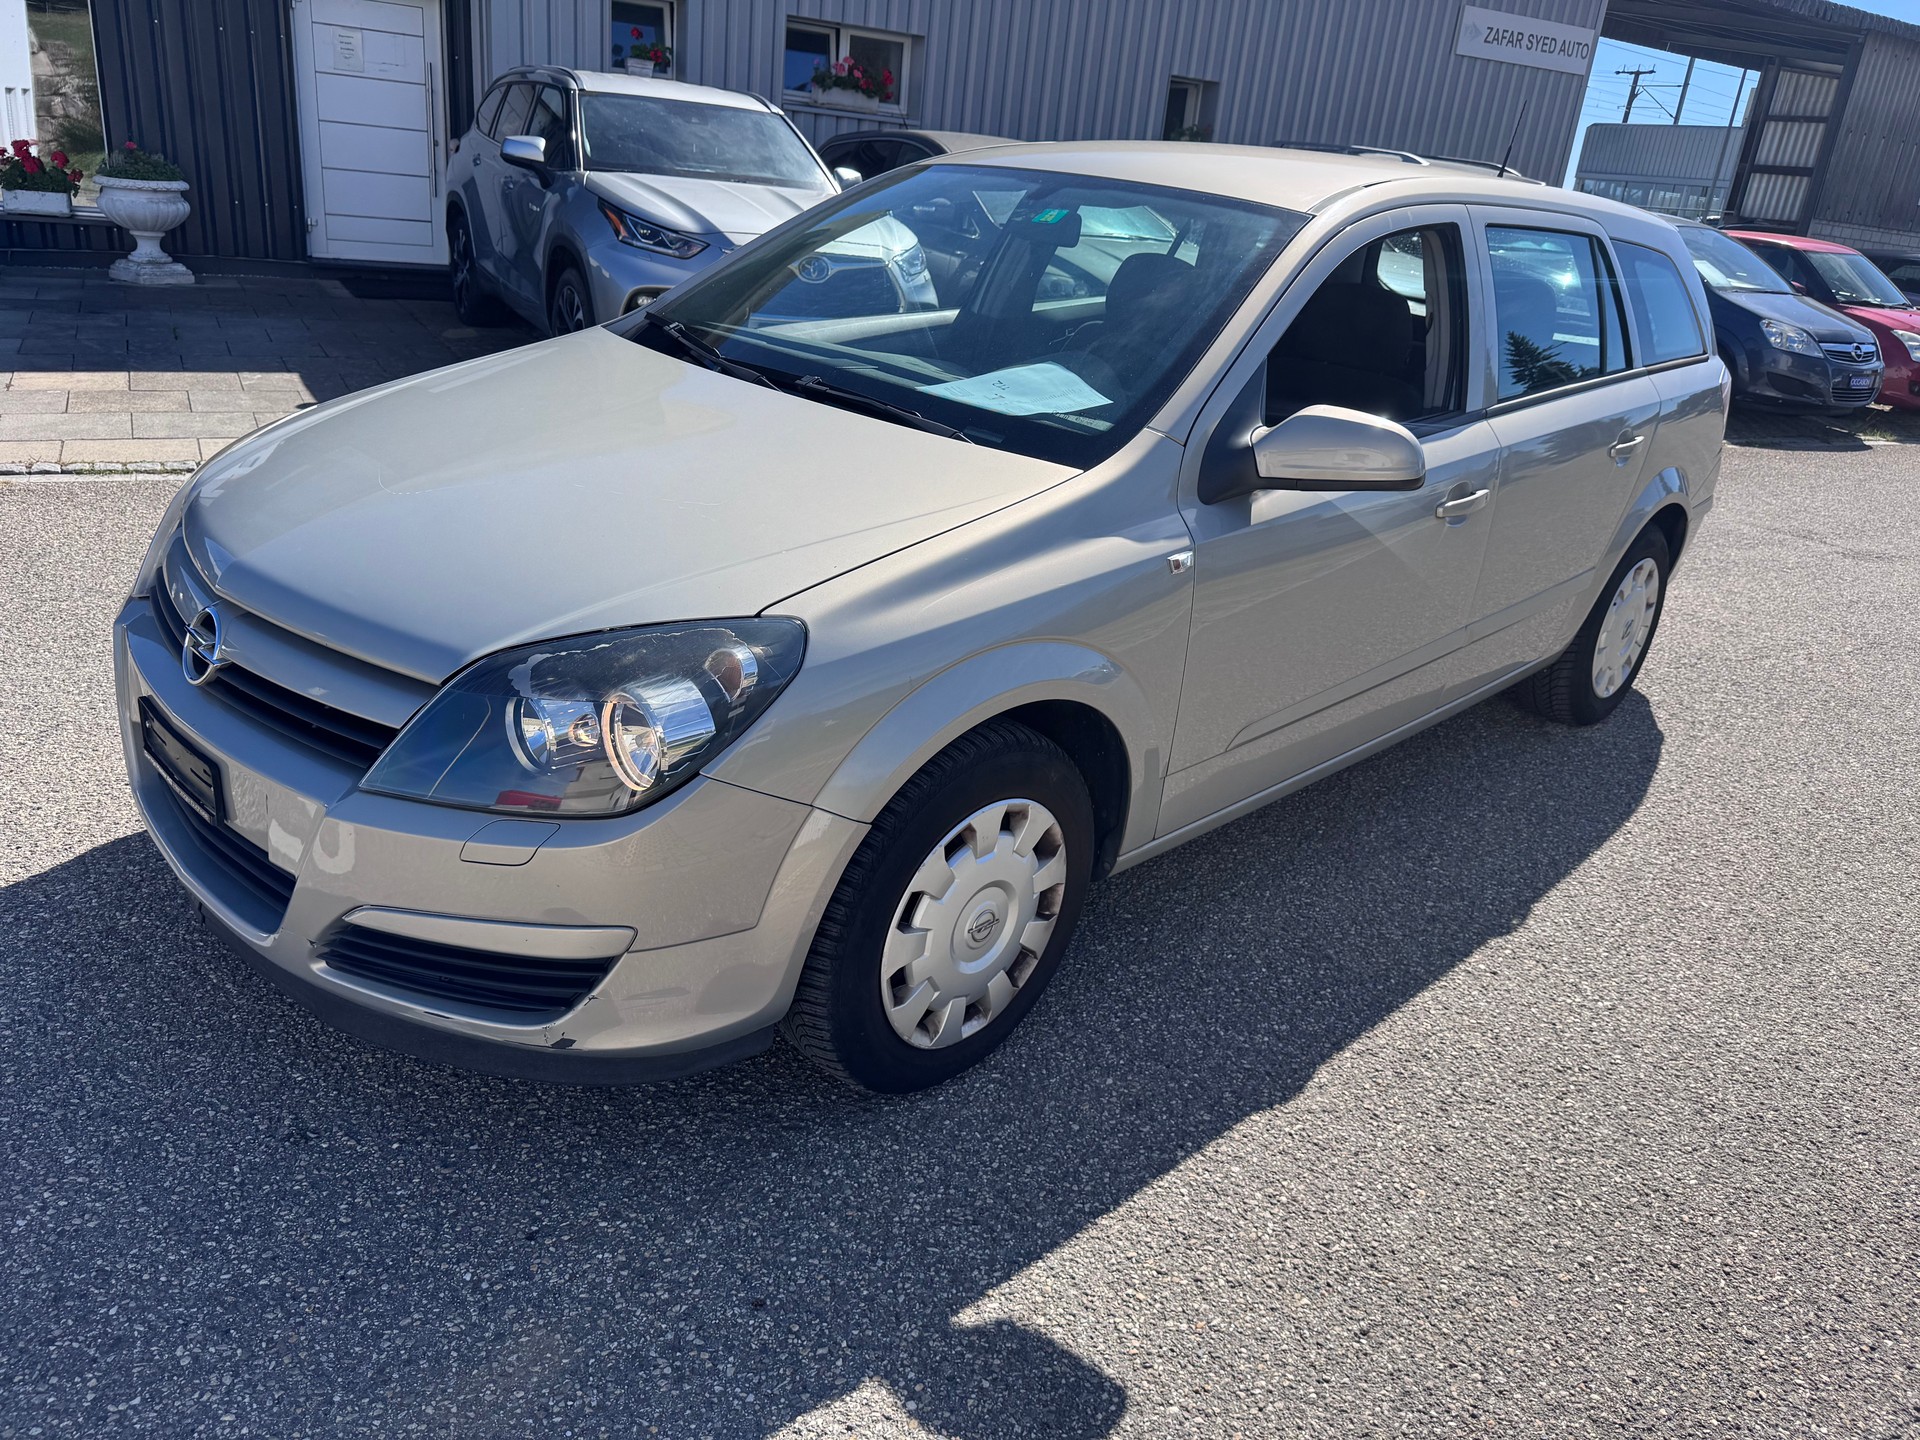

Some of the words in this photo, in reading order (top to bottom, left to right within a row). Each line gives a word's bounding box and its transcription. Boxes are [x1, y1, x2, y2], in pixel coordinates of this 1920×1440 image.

[1483, 26, 1525, 49] ZAFAR
[1526, 33, 1557, 54] SYED
[1557, 39, 1590, 60] AUTO
